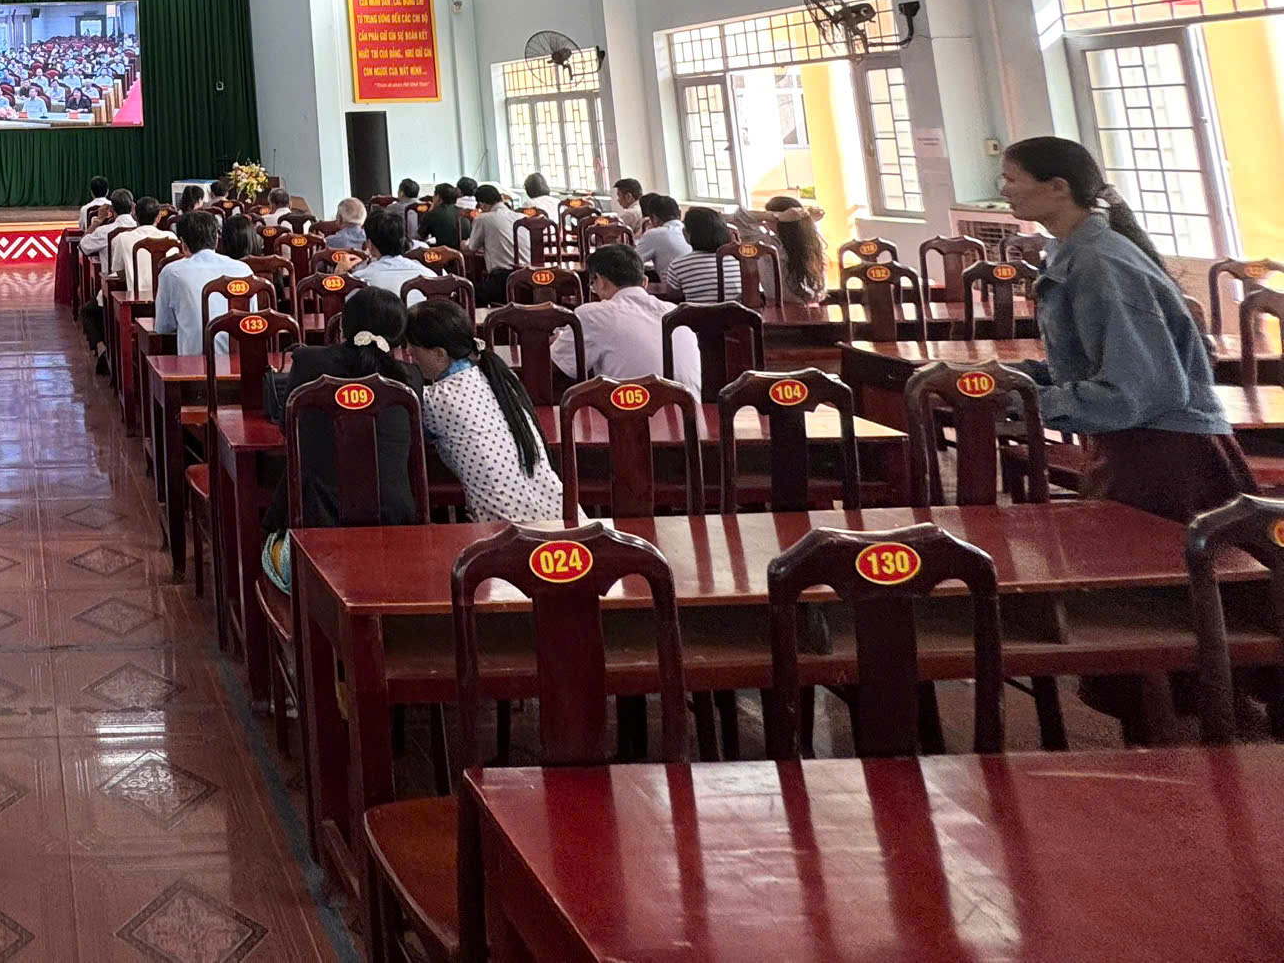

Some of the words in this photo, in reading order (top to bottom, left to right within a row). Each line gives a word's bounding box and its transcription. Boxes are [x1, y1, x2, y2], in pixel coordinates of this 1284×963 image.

[324, 279, 342, 288] 033
[535, 272, 551, 282] 131
[230, 283, 247, 293] 203
[244, 318, 264, 330] 133
[962, 377, 989, 391] 110
[340, 389, 367, 404] 109
[617, 389, 643, 406] 105
[776, 384, 802, 400] 104
[538, 548, 583, 575] 024
[866, 550, 909, 576] 130
